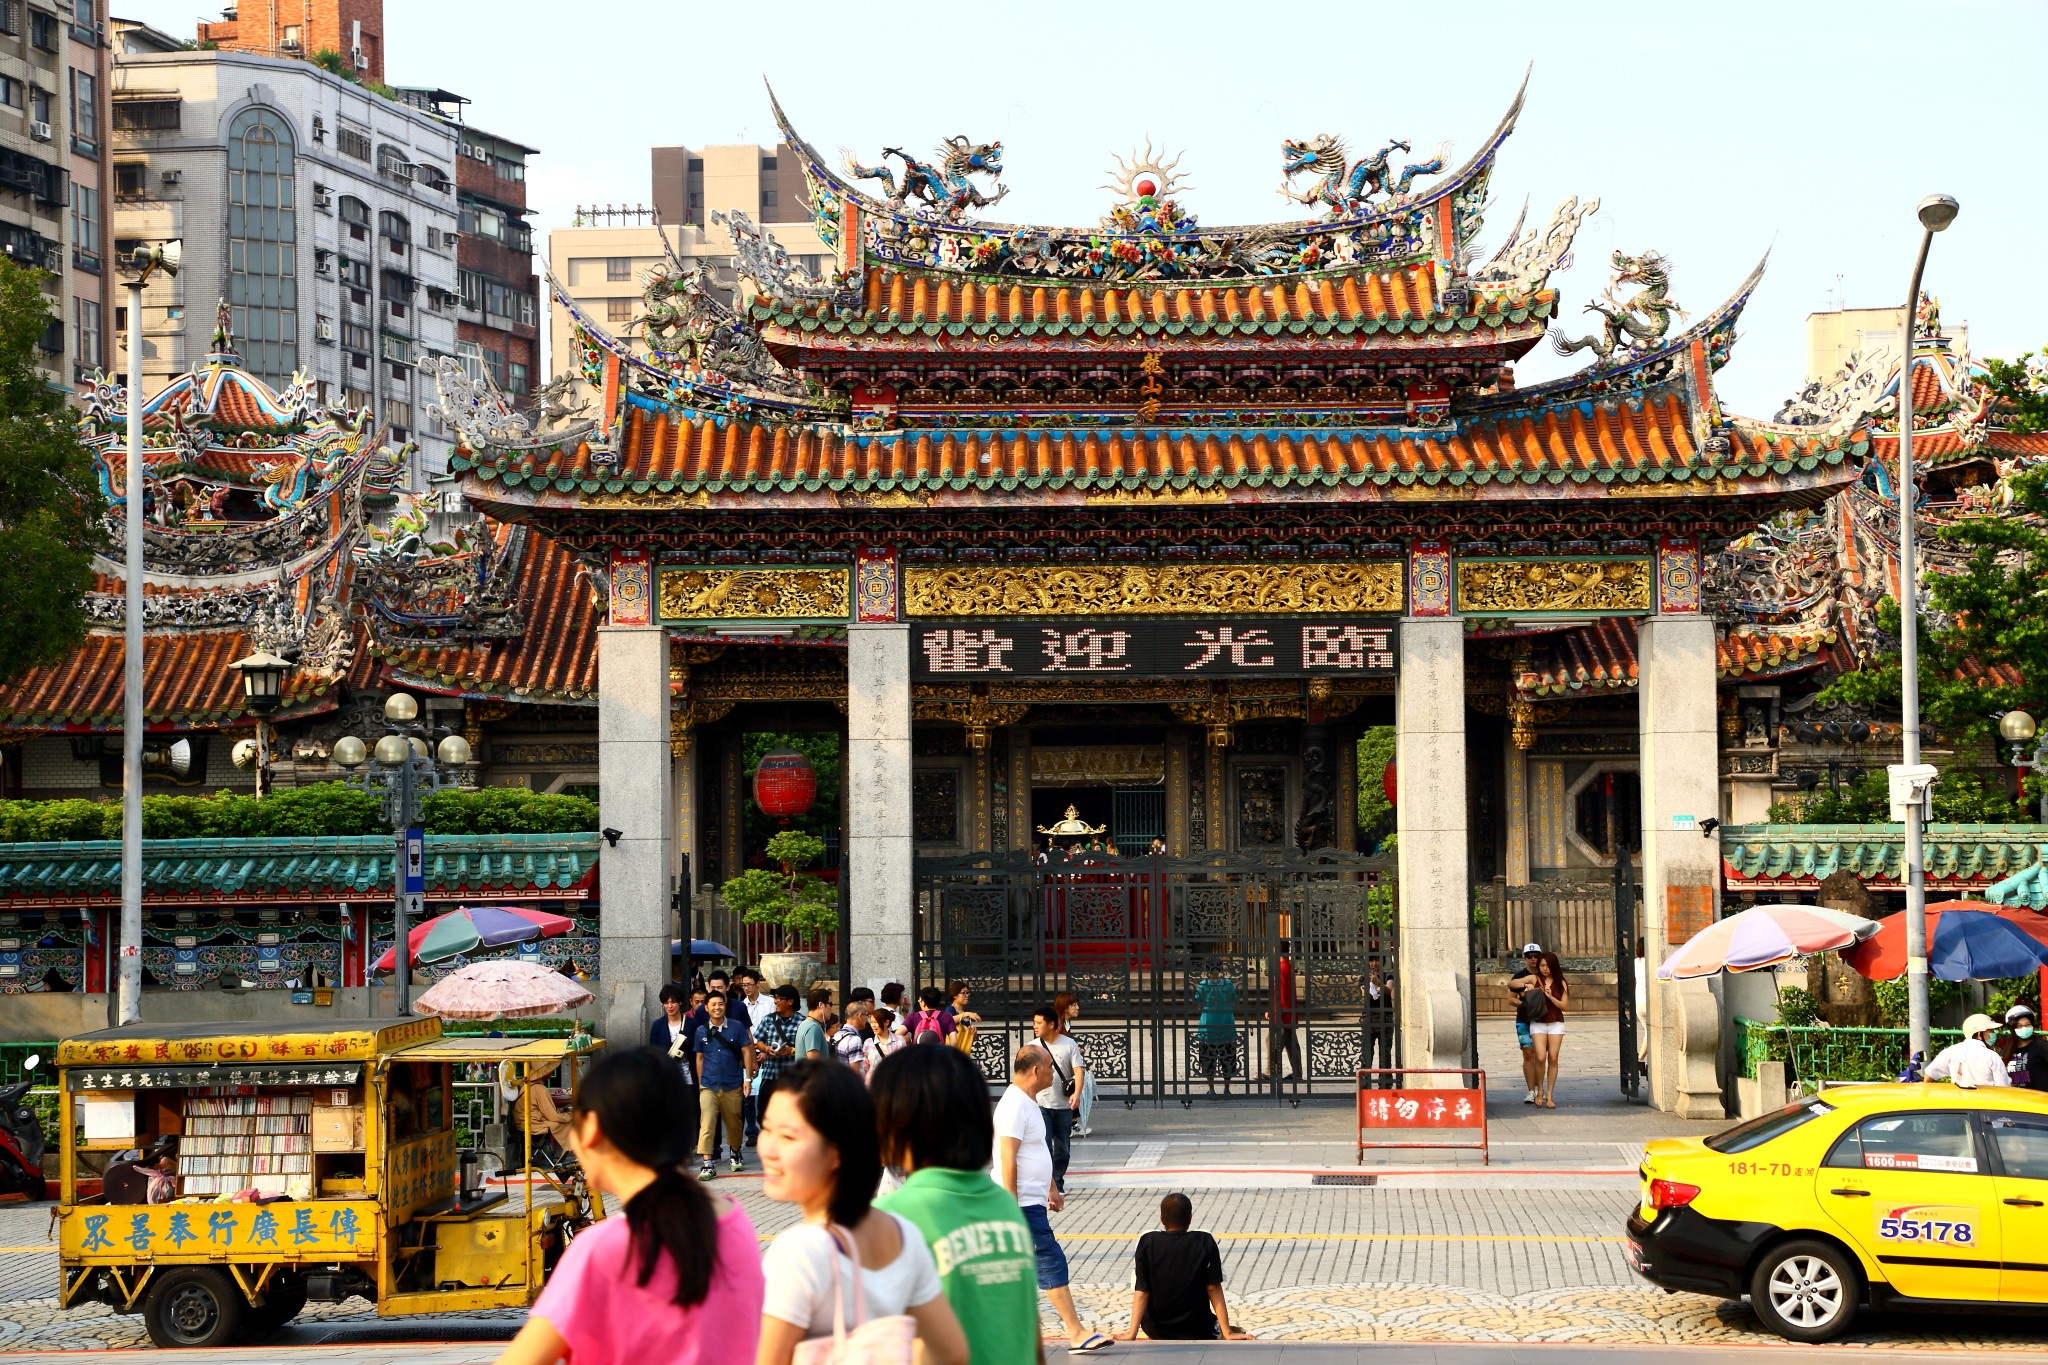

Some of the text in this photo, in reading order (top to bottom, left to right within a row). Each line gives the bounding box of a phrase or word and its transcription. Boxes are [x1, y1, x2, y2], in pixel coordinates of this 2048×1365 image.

[1138, 352, 1165, 422] 龍山寺
[922, 626, 1393, 672] 歡迎光臨
[1369, 1097, 1472, 1121] 請勿停車
[1729, 1162, 1791, 1176] 181-7D
[1867, 1156, 1895, 1167] 1600
[1880, 1218, 1972, 1242] 55178
